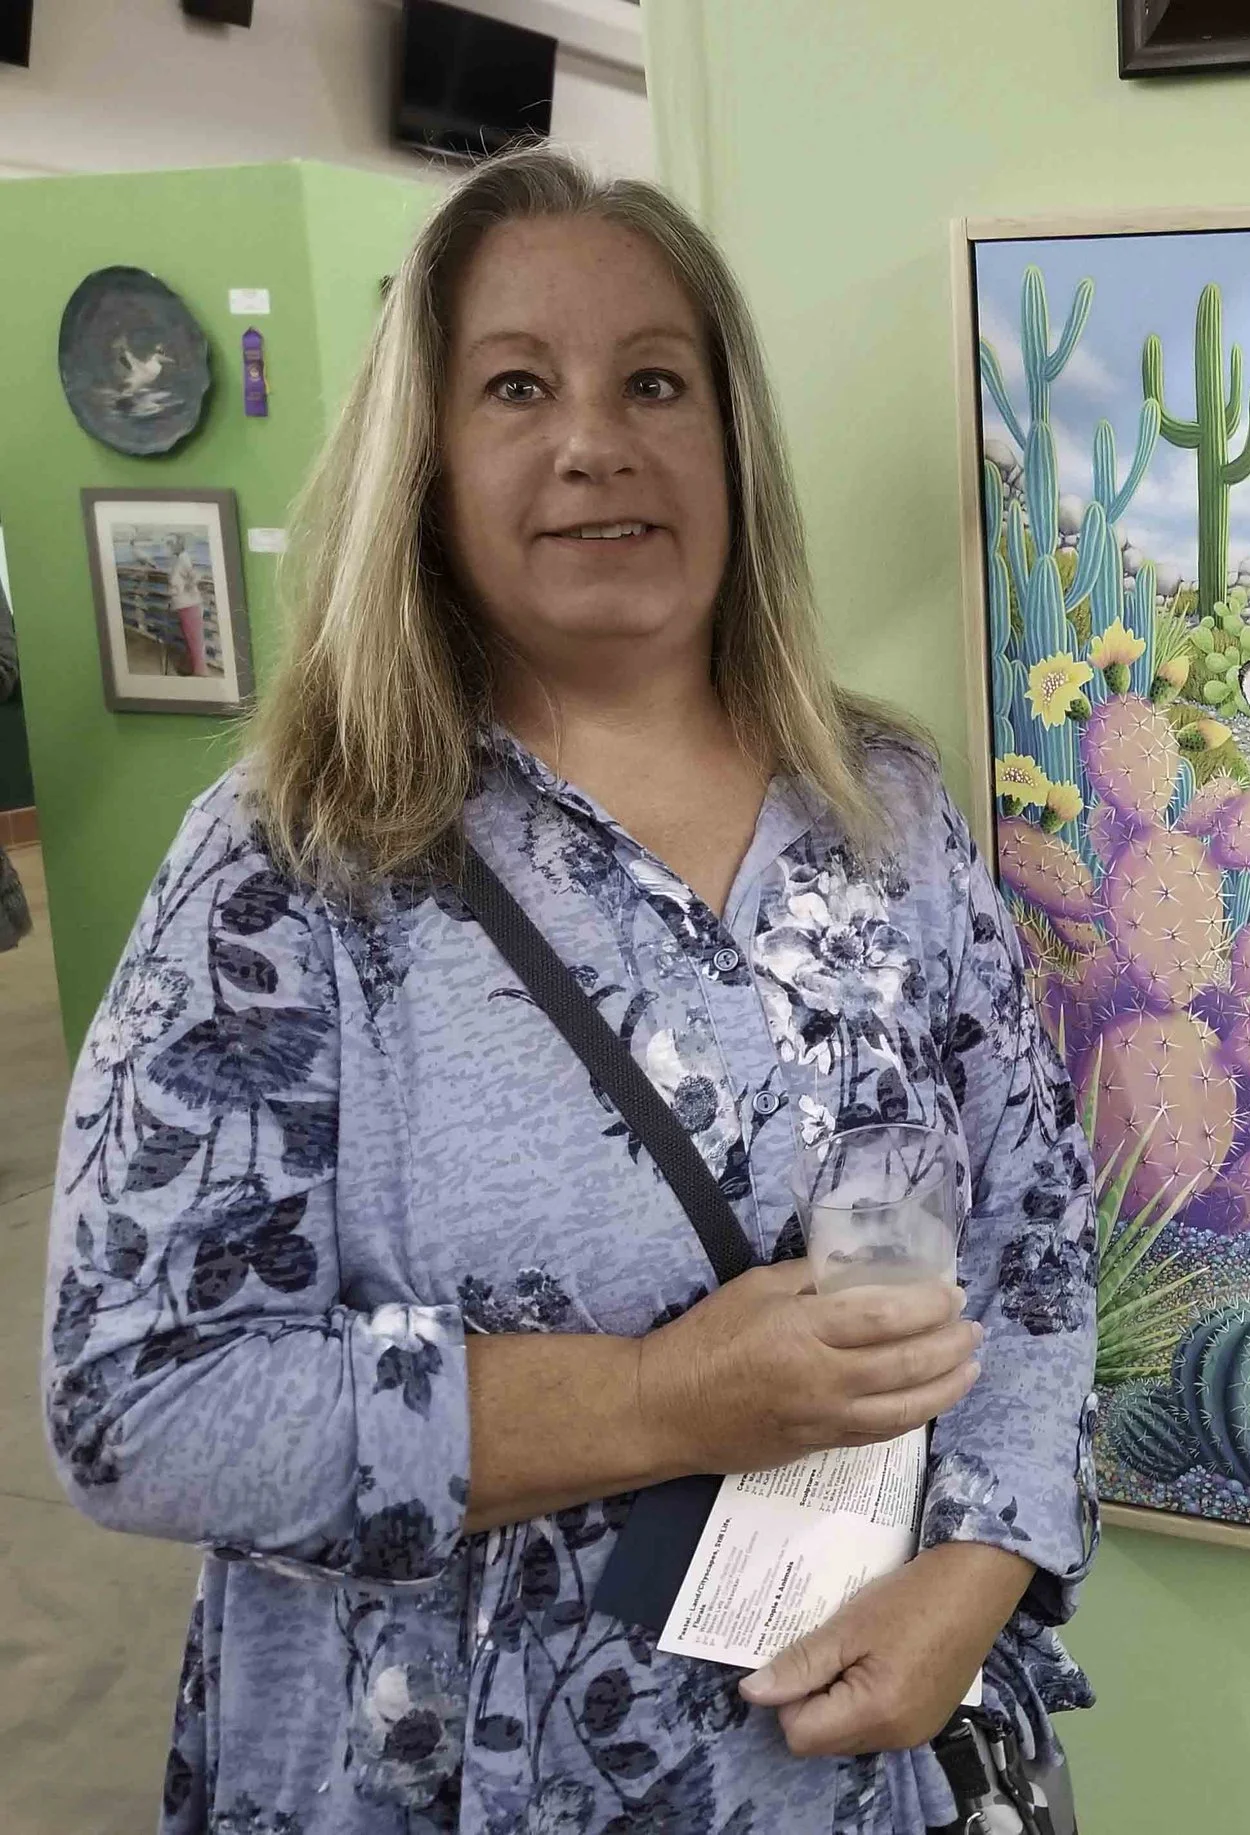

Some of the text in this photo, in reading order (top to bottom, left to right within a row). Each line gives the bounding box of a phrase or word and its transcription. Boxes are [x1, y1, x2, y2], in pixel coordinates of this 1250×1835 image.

[800, 1469, 817, 1507] Sculptures
[678, 1617, 691, 1640] Pastel
[691, 1549, 719, 1611] Land/Cityscapes,
[715, 1533, 725, 1548] Still
[721, 1516, 732, 1533] Life,
[754, 1633, 766, 1655] Pastel
[764, 1601, 779, 1627] People
[774, 1592, 782, 1600] &
[778, 1561, 793, 1591] Animals
[693, 1604, 706, 1628] Florals
